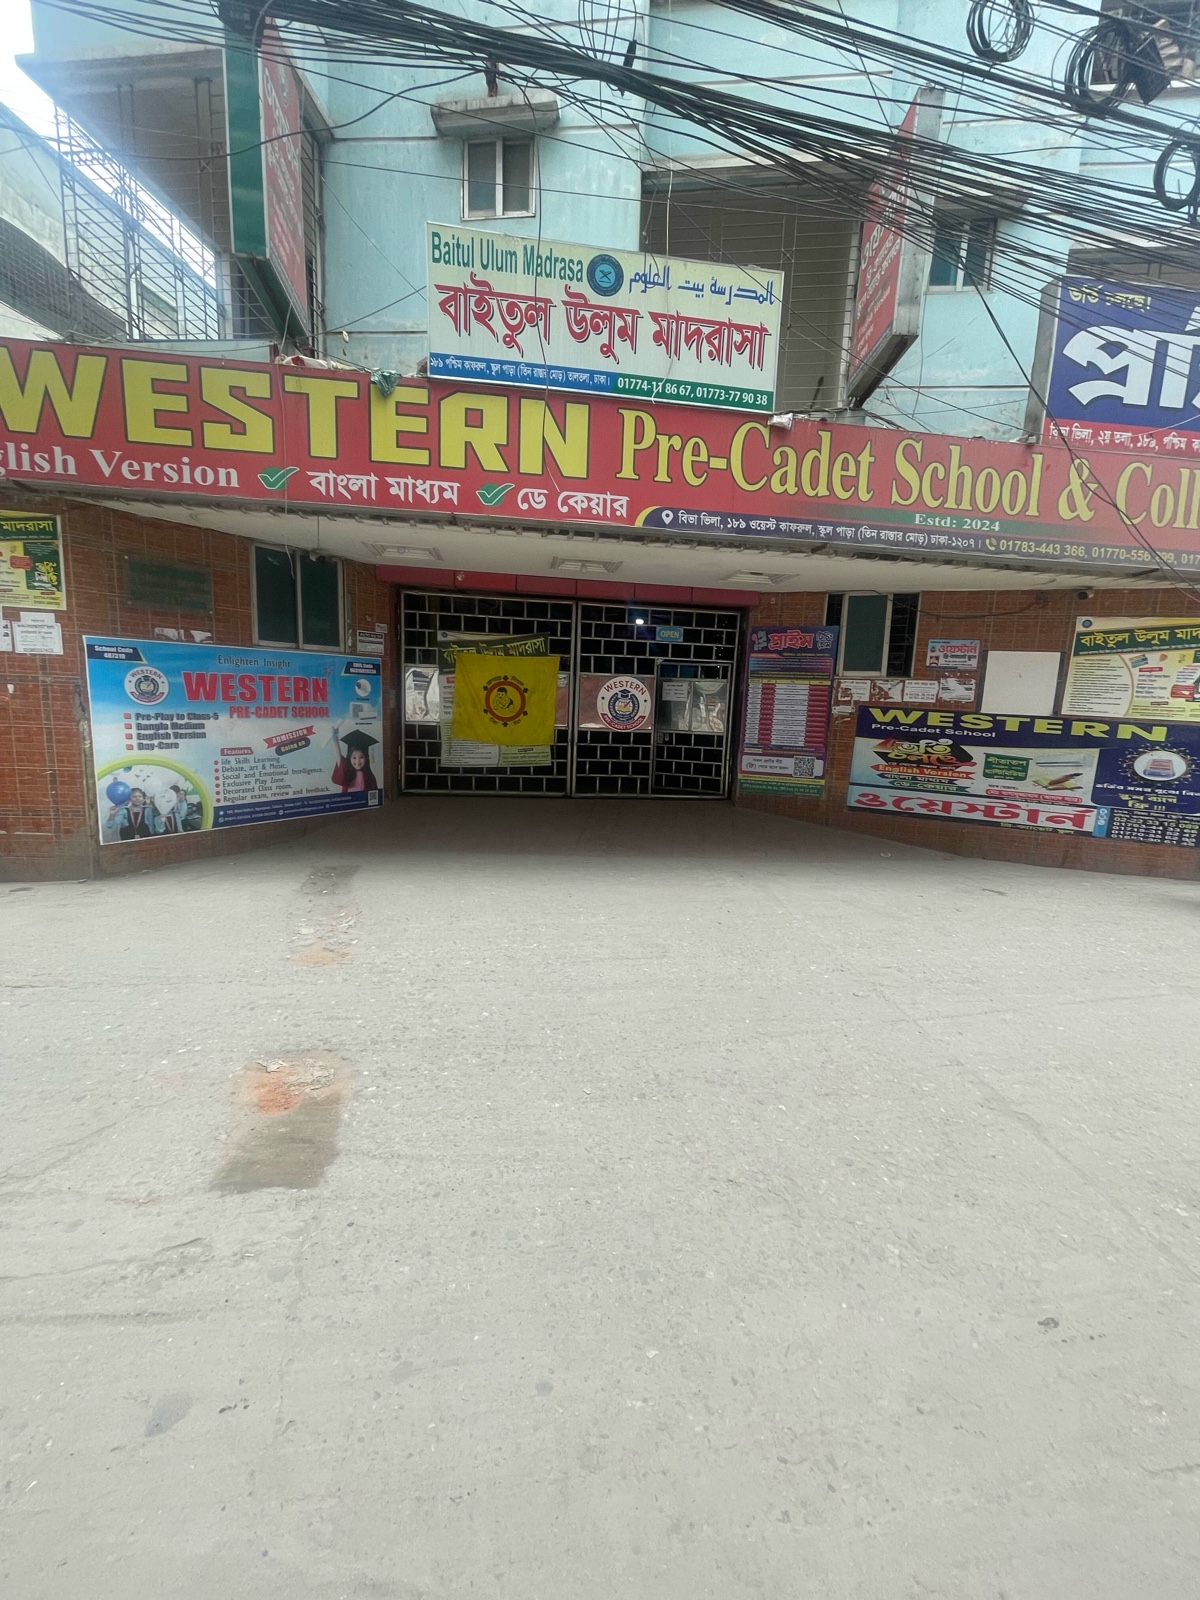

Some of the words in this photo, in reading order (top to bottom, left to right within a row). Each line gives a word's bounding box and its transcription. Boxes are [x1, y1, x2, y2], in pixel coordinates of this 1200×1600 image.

[431, 231, 475, 266] Baitul
[480, 240, 518, 274] Ulum
[522, 244, 584, 283] Madrasa
[433, 272, 557, 358] বাইতুল
[561, 284, 643, 363] উলুম
[648, 311, 772, 371] মাদরাসা
[665, 383, 678, 395] 86
[696, 388, 740, 402] 01773-77
[742, 392, 754, 404] 90
[756, 393, 768, 406] 38
[0, 346, 589, 479] WESTERN
[615, 408, 876, 502] Pre-Cadet
[891, 438, 1043, 517] School
[1058, 458, 1098, 522] &
[88, 449, 240, 489] Version
[306, 470, 379, 501] বাংলা
[384, 475, 461, 506] মাধ্যম
[517, 487, 549, 512] ডে
[556, 490, 631, 518] কেয়ার
[678, 510, 699, 526] বিভা
[915, 513, 957, 529] Estd:
[961, 517, 1000, 532] 2024
[999, 540, 1060, 555] 01783-443
[1064, 545, 1088, 559] 366,
[660, 630, 680, 638] OPEN
[768, 630, 815, 650] প্রাইম
[1080, 631, 1131, 649] বাইতুল
[1133, 629, 1171, 645] উলুম
[217, 655, 260, 668] Enlighten
[263, 657, 291, 668] Insight
[129, 669, 163, 680] WESTERN
[182, 671, 329, 703] WESTERN
[603, 680, 647, 696] WESTERN
[135, 712, 174, 722] Pre-Play
[176, 713, 185, 721] to
[186, 712, 219, 721] Class-5
[229, 705, 289, 719] PRE-CADET
[291, 706, 330, 719] SCHOOL
[136, 722, 169, 732] Bangla
[170, 722, 206, 731] Medium
[869, 708, 1168, 742] WESTERN
[871, 724, 940, 734] Pre-Cadet
[944, 730, 996, 738] School
[136, 732, 171, 741] English
[172, 731, 207, 740] Version
[272, 728, 308, 744] ADMISSION
[137, 742, 180, 752] Day-Care
[878, 764, 920, 775] English
[923, 768, 968, 778] Version
[854, 792, 1099, 831] ওয়েস্টার্ন
